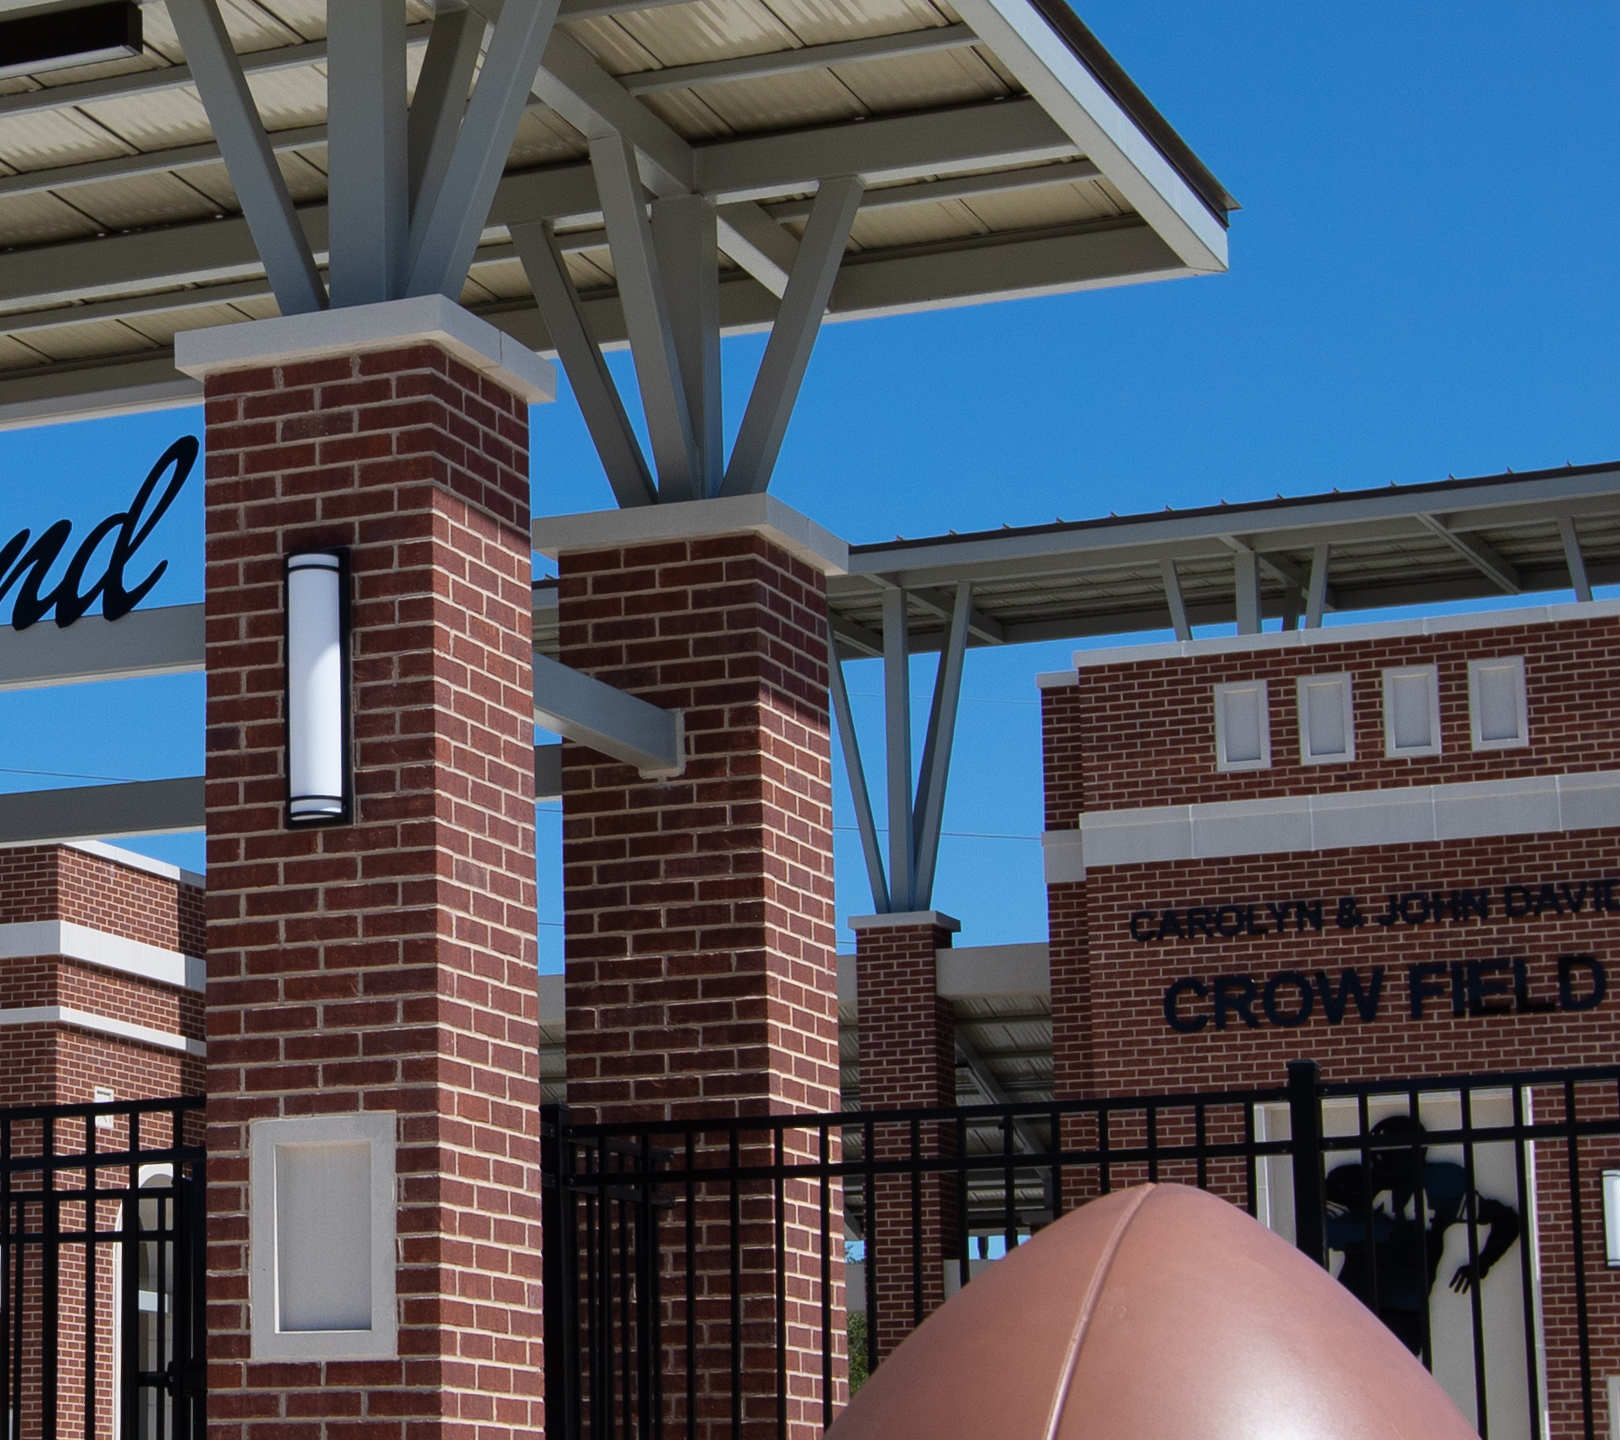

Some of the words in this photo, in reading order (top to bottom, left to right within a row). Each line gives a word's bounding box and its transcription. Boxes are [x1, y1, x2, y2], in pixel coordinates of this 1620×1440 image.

[1129, 898, 1323, 943] CAROLYN
[1335, 896, 1366, 929] &
[1378, 887, 1489, 927] JOHN
[1162, 965, 1385, 1033] CROW
[1409, 955, 1608, 1021] FIELD
